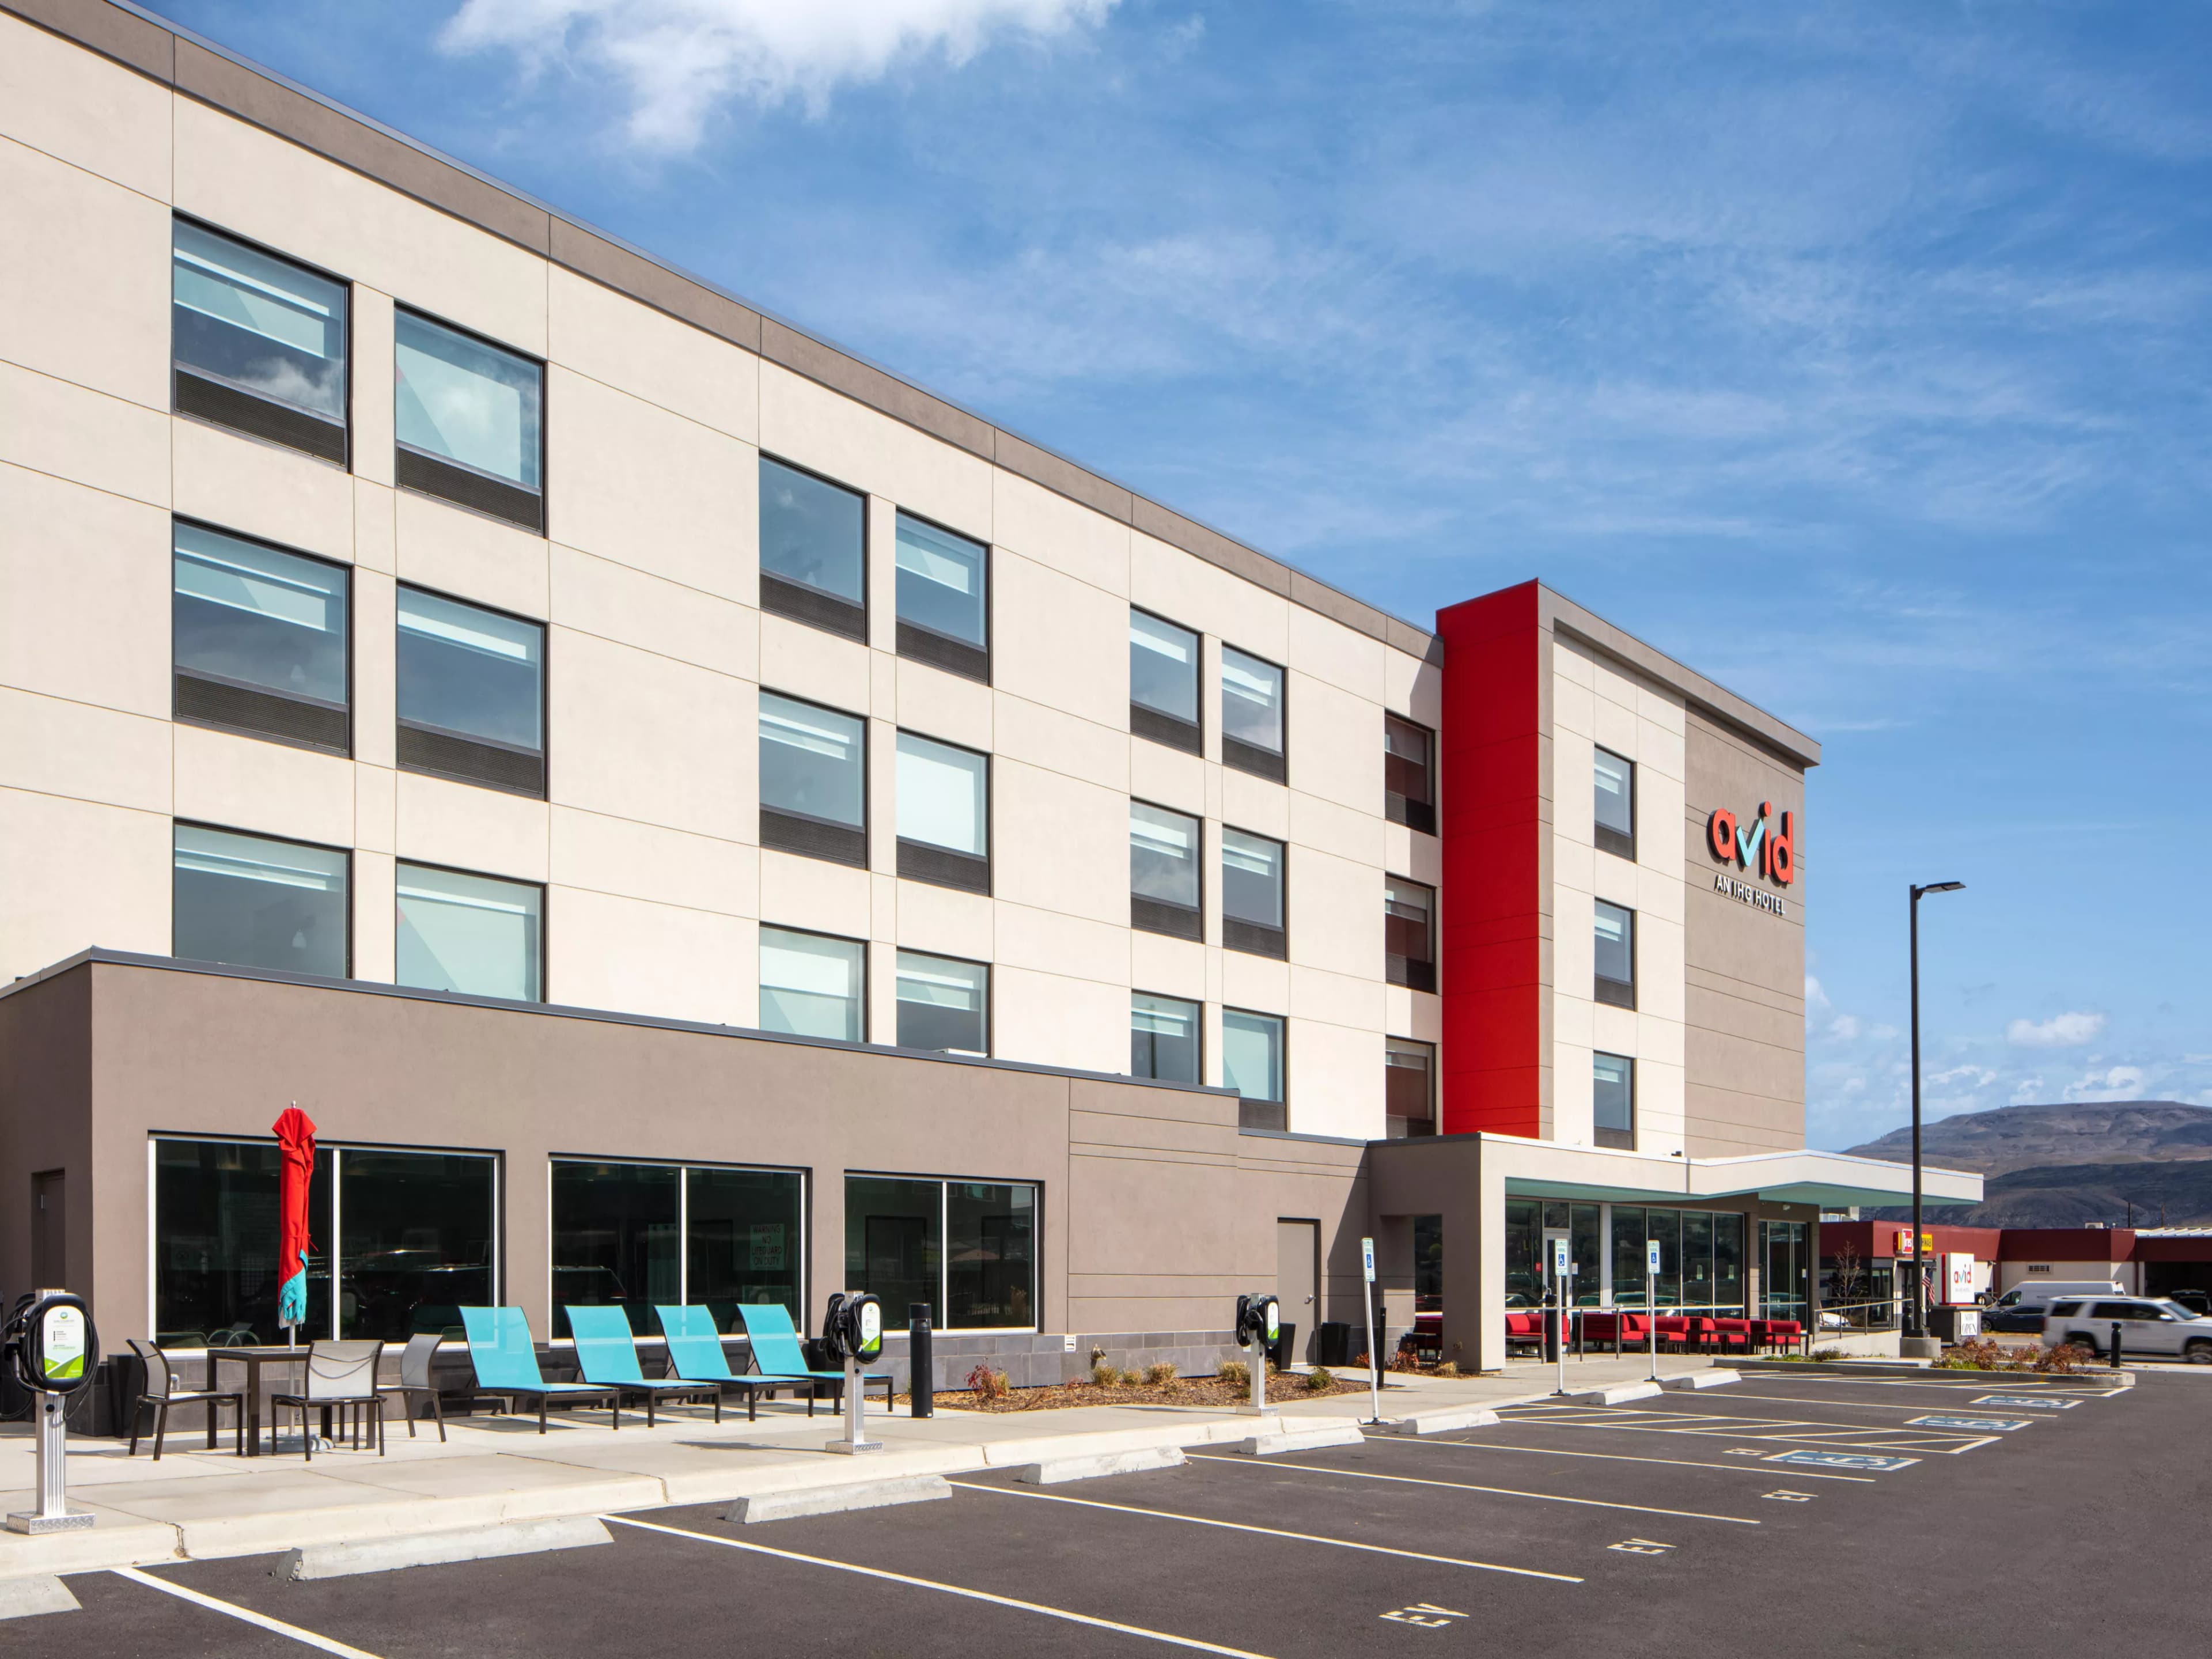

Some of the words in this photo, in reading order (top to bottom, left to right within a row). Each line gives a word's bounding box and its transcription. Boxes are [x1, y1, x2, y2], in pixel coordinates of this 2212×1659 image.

[1708, 801, 1793, 884] avid
[1716, 874, 1730, 892] AN
[1733, 881, 1752, 900] IHG
[1755, 889, 1786, 914] HOTEL
[753, 1224, 781, 1234] WARNING
[762, 1235, 771, 1244] NO
[752, 1245, 782, 1255] LIFEGUARD
[753, 1256, 763, 1266] ON
[764, 1256, 779, 1265] DUTY
[1953, 1263, 1972, 1283] avid
[1961, 1323, 1977, 1334] OPEN
[1760, 1490, 1819, 1502] EV
[1606, 1538, 1677, 1555] EV
[1378, 1603, 1469, 1627] EV
